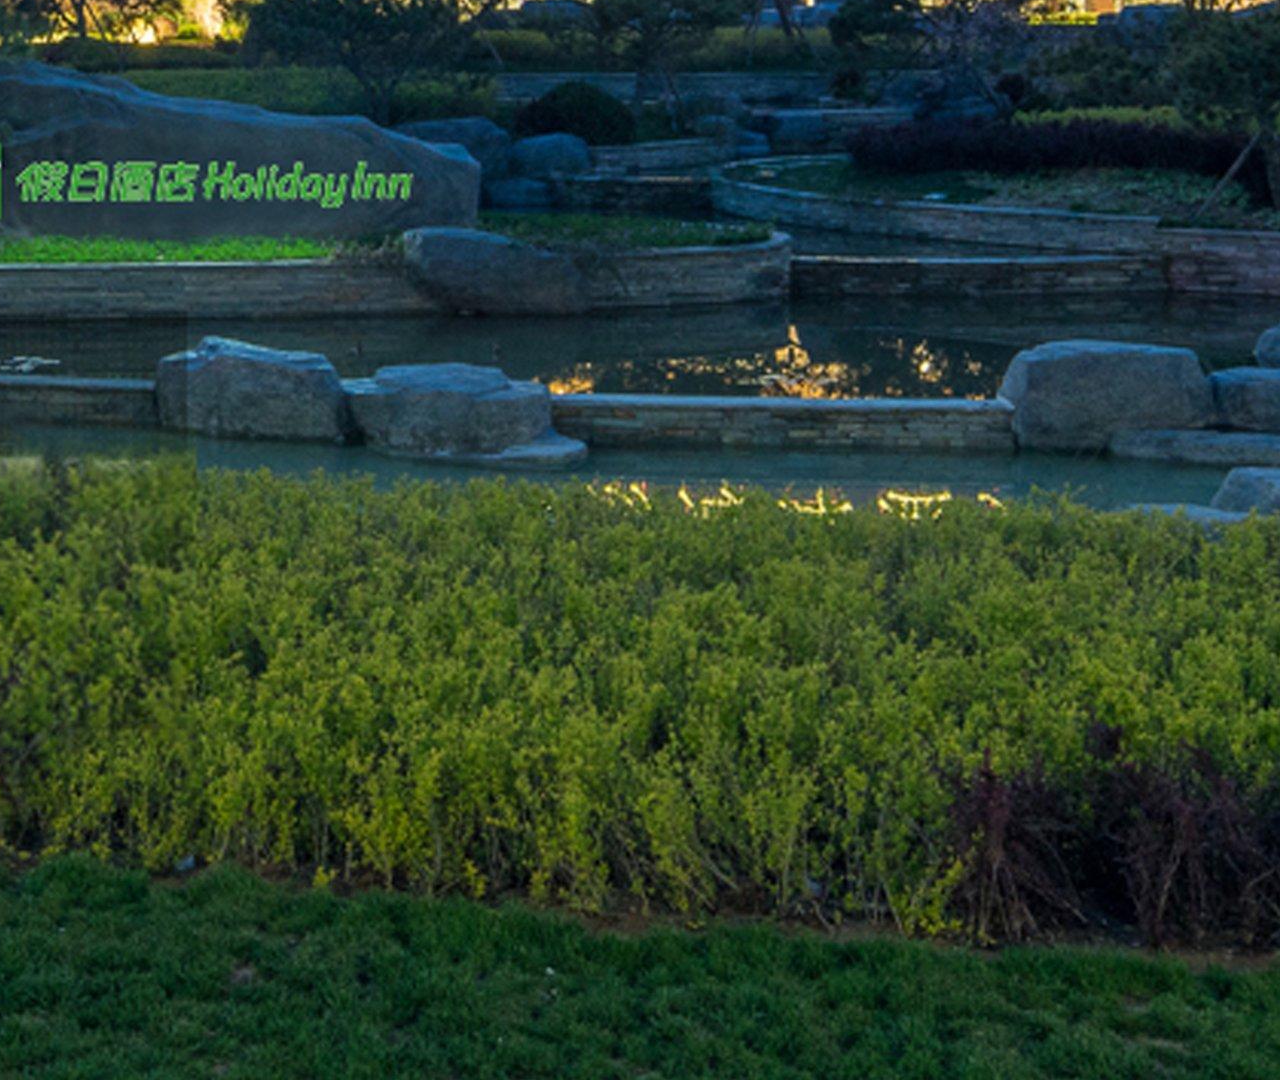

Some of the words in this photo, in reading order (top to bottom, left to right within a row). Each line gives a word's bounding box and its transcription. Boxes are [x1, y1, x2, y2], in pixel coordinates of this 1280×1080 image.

[17, 161, 200, 202] 假日酒店
[203, 161, 349, 208] Holiday
[353, 161, 413, 201] Inn
